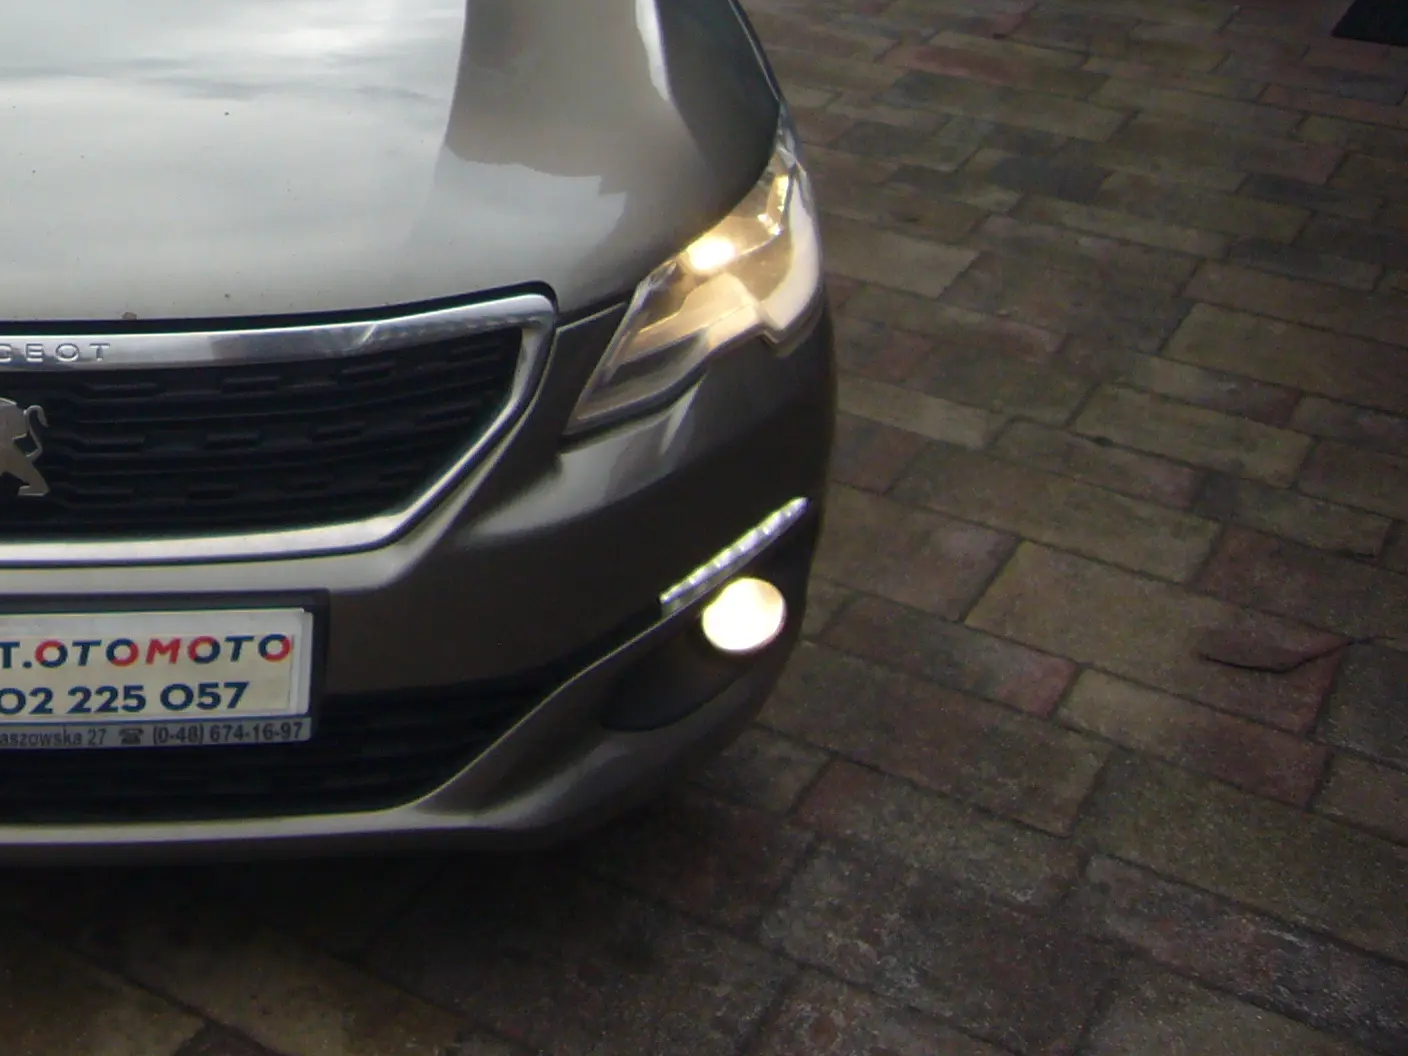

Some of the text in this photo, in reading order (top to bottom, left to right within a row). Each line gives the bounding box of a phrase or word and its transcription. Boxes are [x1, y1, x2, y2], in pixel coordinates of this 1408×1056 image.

[67, 685, 147, 714] 225
[160, 681, 250, 712] 057
[87, 727, 107, 745] 27
[152, 723, 205, 745] (0-48)
[209, 721, 304, 742] 674-16-97
